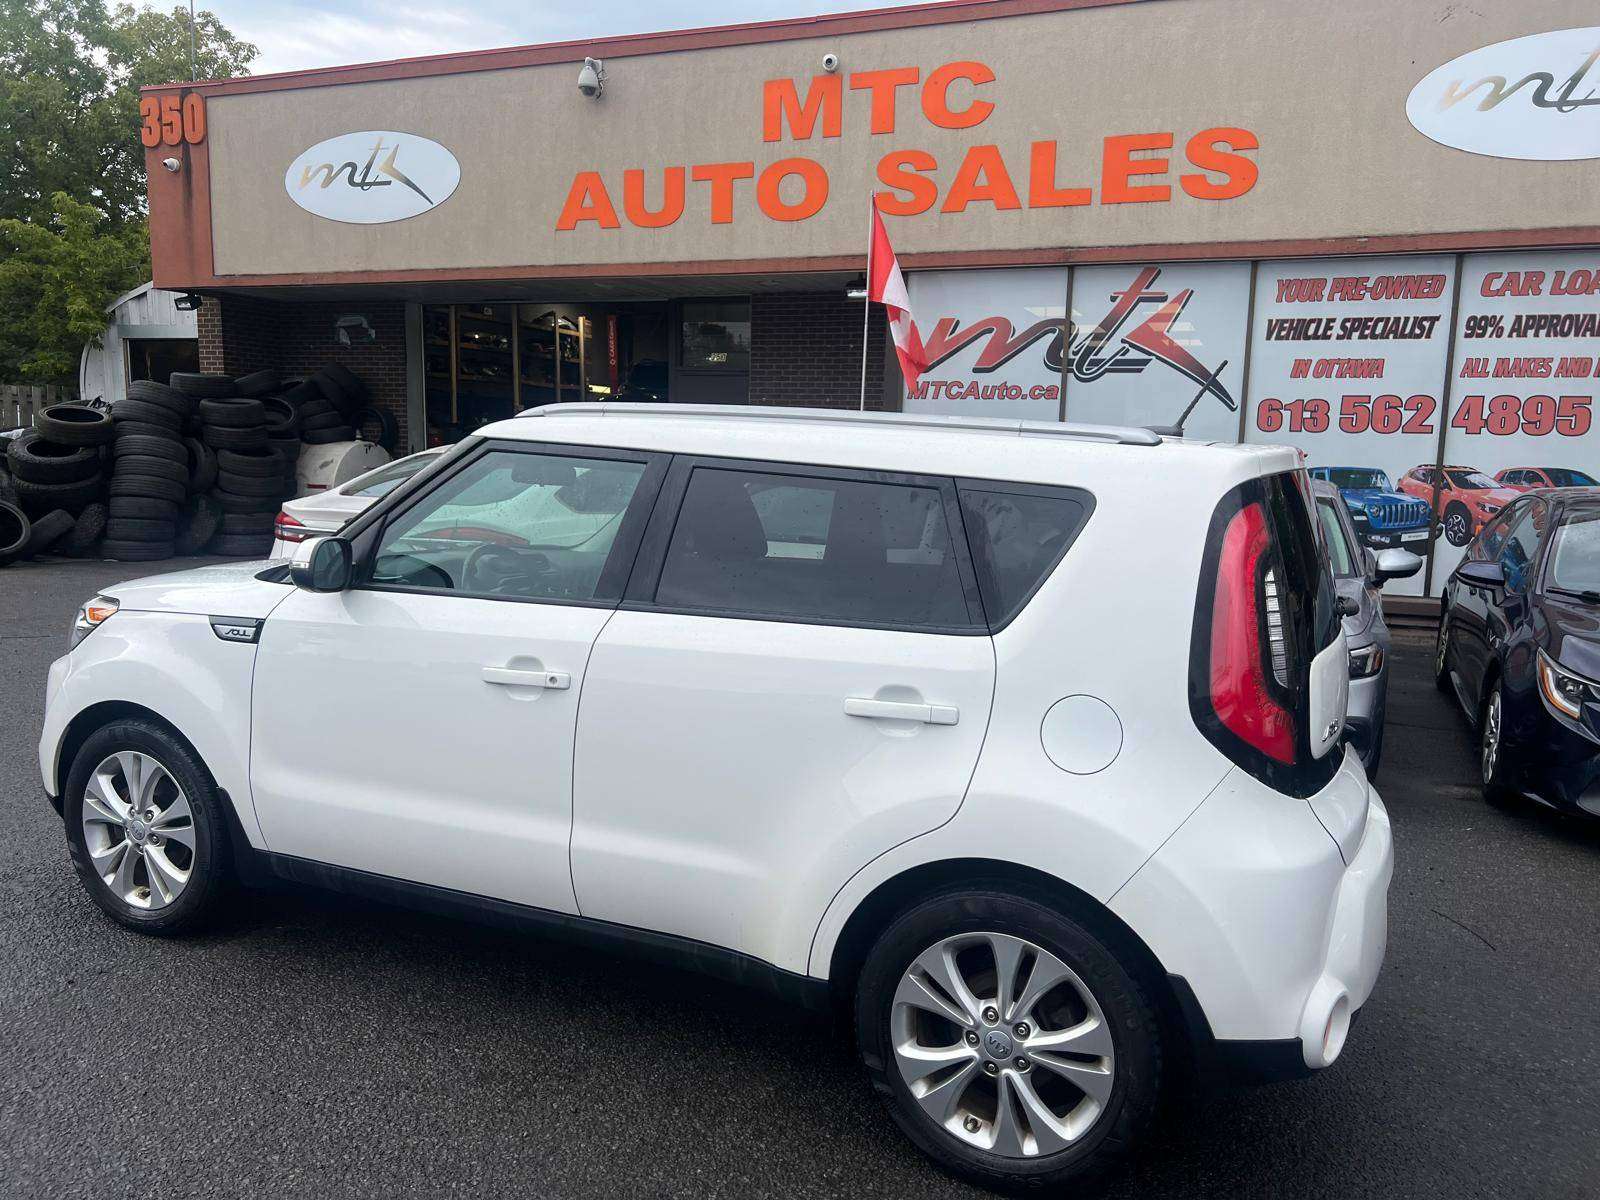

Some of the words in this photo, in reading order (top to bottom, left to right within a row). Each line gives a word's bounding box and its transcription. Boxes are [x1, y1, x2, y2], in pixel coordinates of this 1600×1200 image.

[763, 61, 995, 142] MTC
[140, 92, 205, 148] 350
[555, 157, 829, 231] AUTO
[875, 127, 1259, 215] SALES
[1276, 276, 1328, 303] YOUR
[1327, 274, 1447, 302] PRE-OWNED
[1480, 271, 1546, 298] CAR
[1265, 316, 1338, 341] VEHICLE
[1335, 313, 1442, 340] SPECIALIST
[1463, 314, 1505, 339] 99%
[1290, 359, 1311, 380] IN
[1312, 357, 1386, 379] OTTAWA
[1459, 357, 1490, 378] ALL
[1492, 357, 1554, 378] MAKES
[1554, 357, 1593, 378] AND
[907, 380, 1060, 401] MTCAuto.ca
[1256, 398, 1331, 434] 613
[1338, 394, 1437, 435] 562
[1451, 394, 1593, 437] 4895
